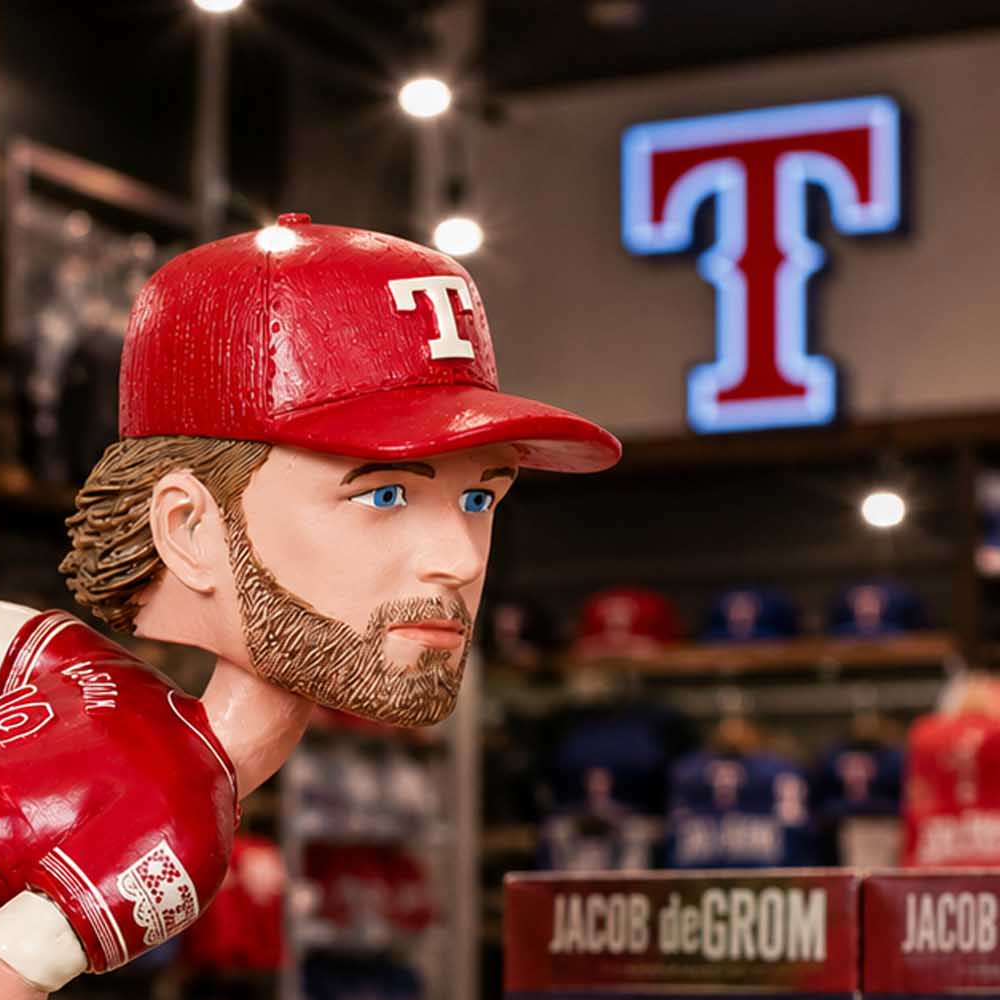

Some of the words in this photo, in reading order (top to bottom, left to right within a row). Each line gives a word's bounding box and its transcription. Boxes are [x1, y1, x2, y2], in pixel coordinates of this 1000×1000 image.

[621, 96, 901, 433] T
[388, 275, 476, 360] T
[549, 893, 651, 956] JACOB
[658, 886, 828, 963] deGROM
[901, 892, 998, 954] JACOB
